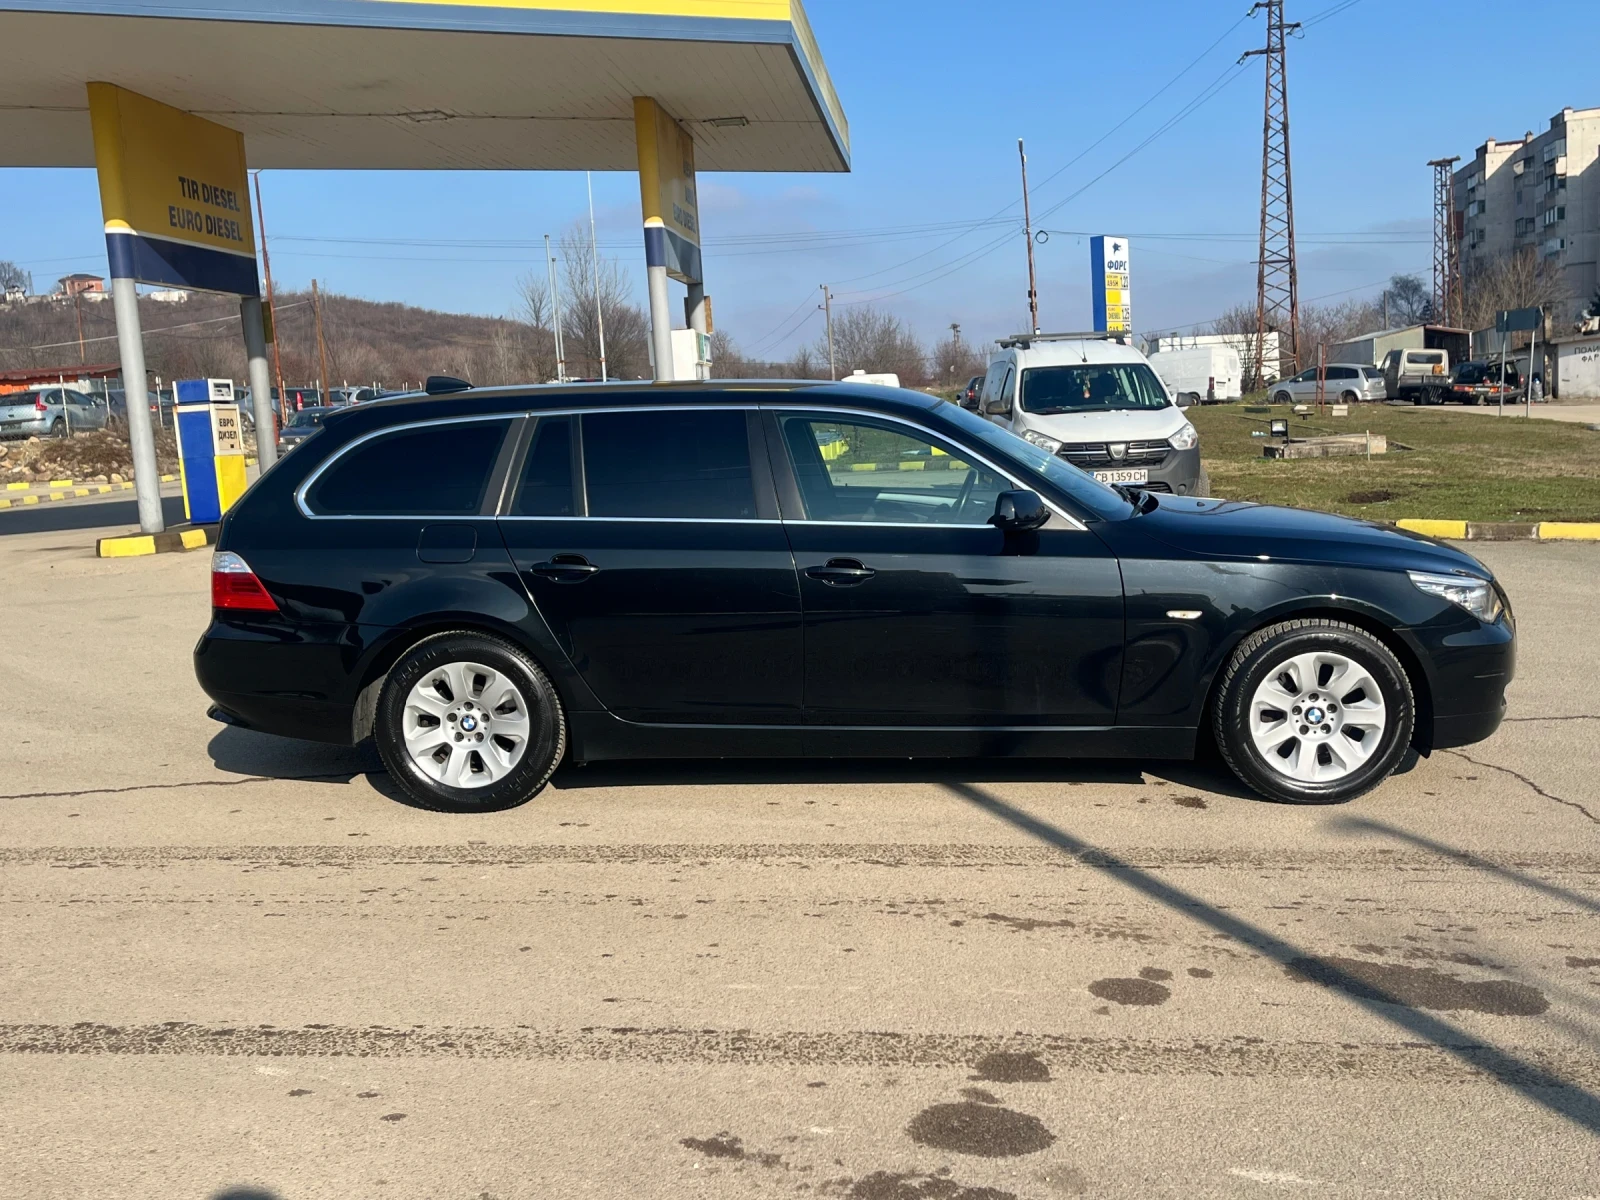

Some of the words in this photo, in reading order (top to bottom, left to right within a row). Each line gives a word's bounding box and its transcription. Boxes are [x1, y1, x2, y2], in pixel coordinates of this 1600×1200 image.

[178, 175, 200, 201] TIR
[201, 182, 240, 212] DIESEL
[168, 205, 203, 233] EURO
[204, 214, 243, 242] DIESEL
[1107, 260, 1127, 271] ФОРС
[219, 418, 235, 427] ЕВРО
[218, 430, 238, 441] ДИЗЕЛ
[1110, 471, 1132, 482] 1359
[1133, 471, 1146, 481] CH
